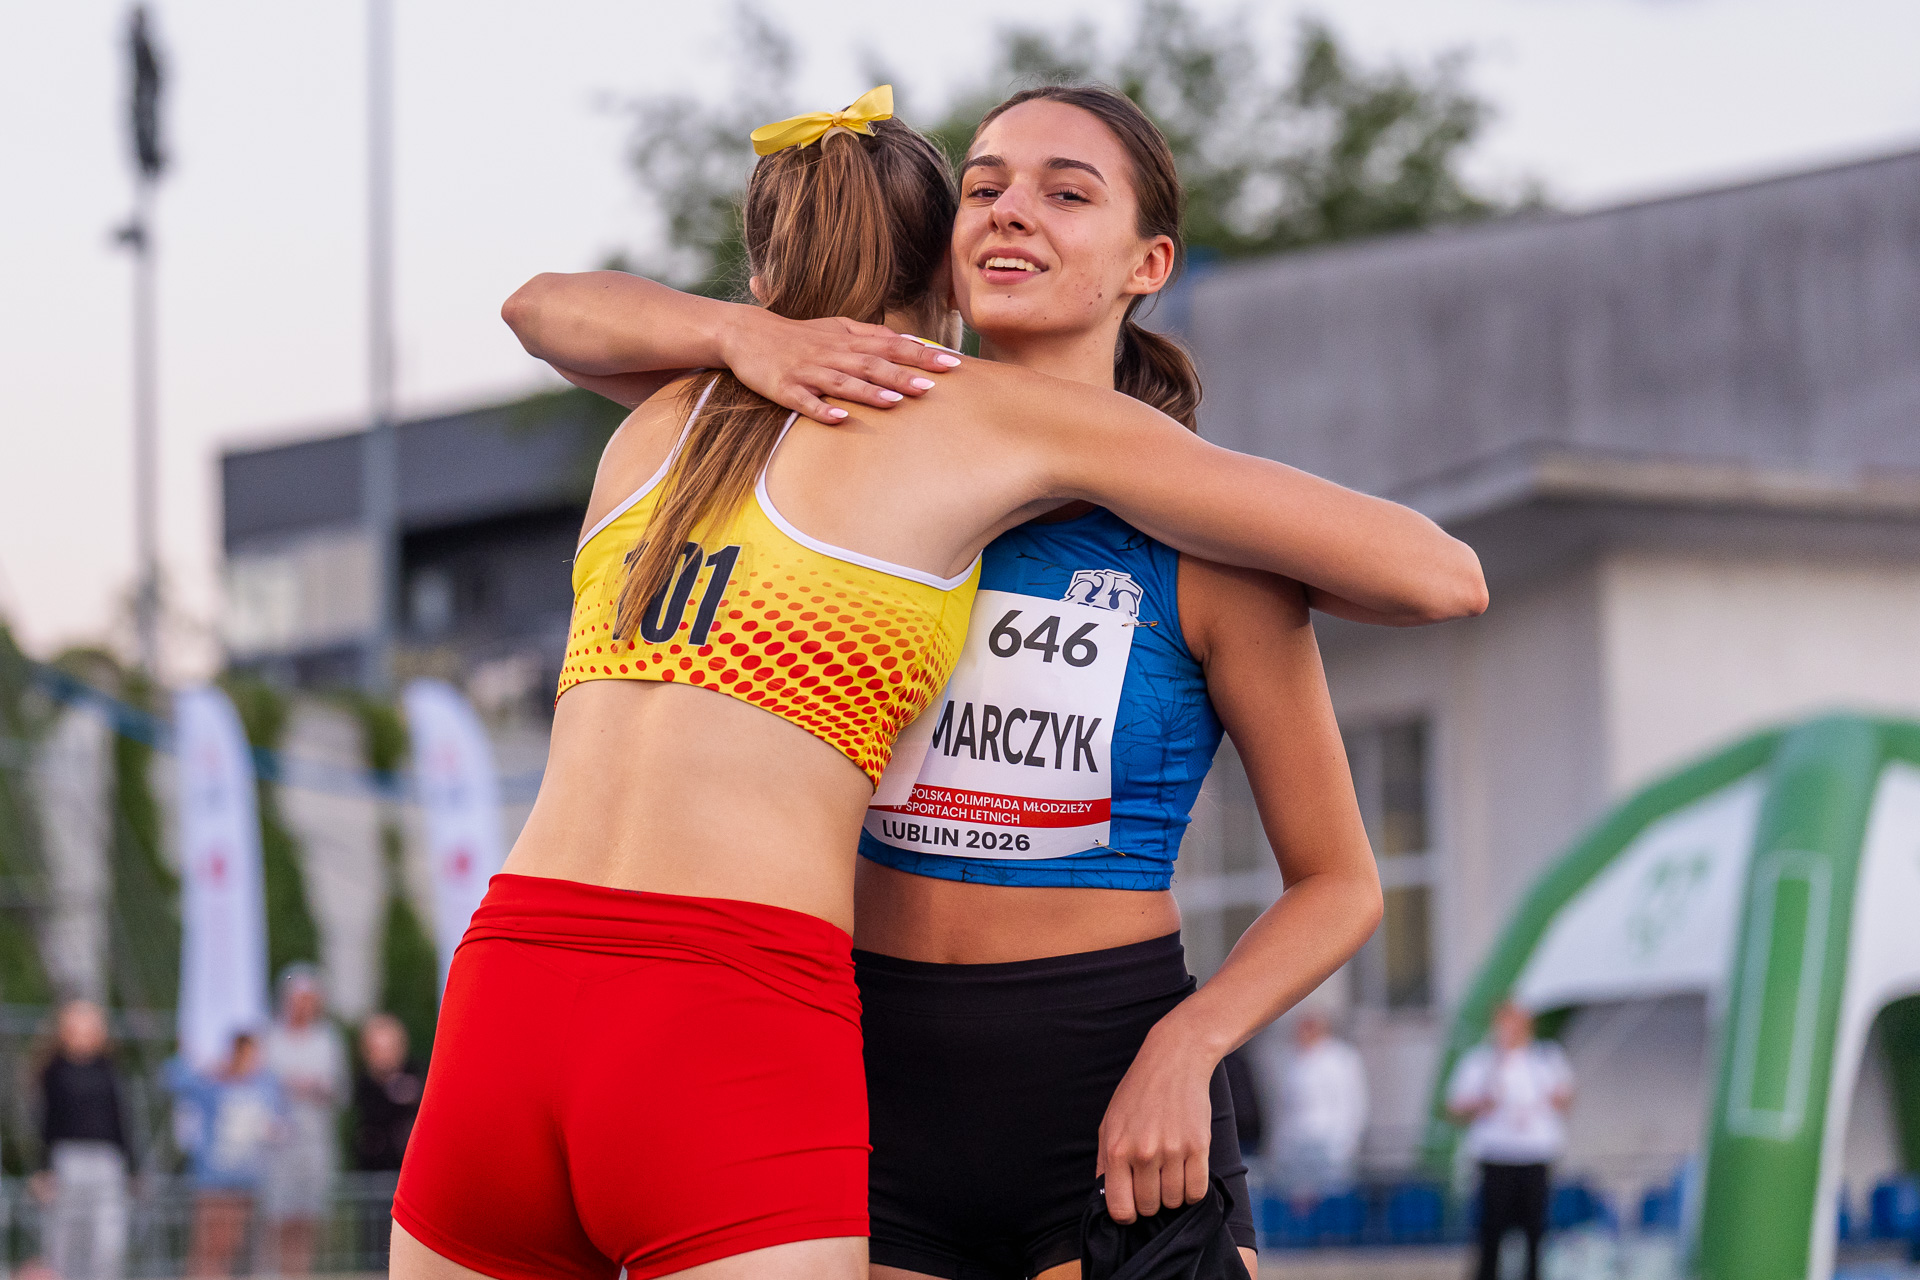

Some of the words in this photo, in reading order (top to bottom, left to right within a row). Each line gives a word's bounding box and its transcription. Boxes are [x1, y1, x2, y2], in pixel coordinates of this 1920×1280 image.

[988, 609, 1100, 668] 646
[932, 700, 1102, 773] MARCZYK
[906, 801, 967, 819] SPORTACH
[970, 809, 1020, 825] LETNICH
[955, 793, 1020, 811] OLIMPIADA
[1023, 801, 1093, 814] MŁODZIEŻY
[882, 819, 959, 847] LUBLIN
[966, 830, 1031, 852] 2026
